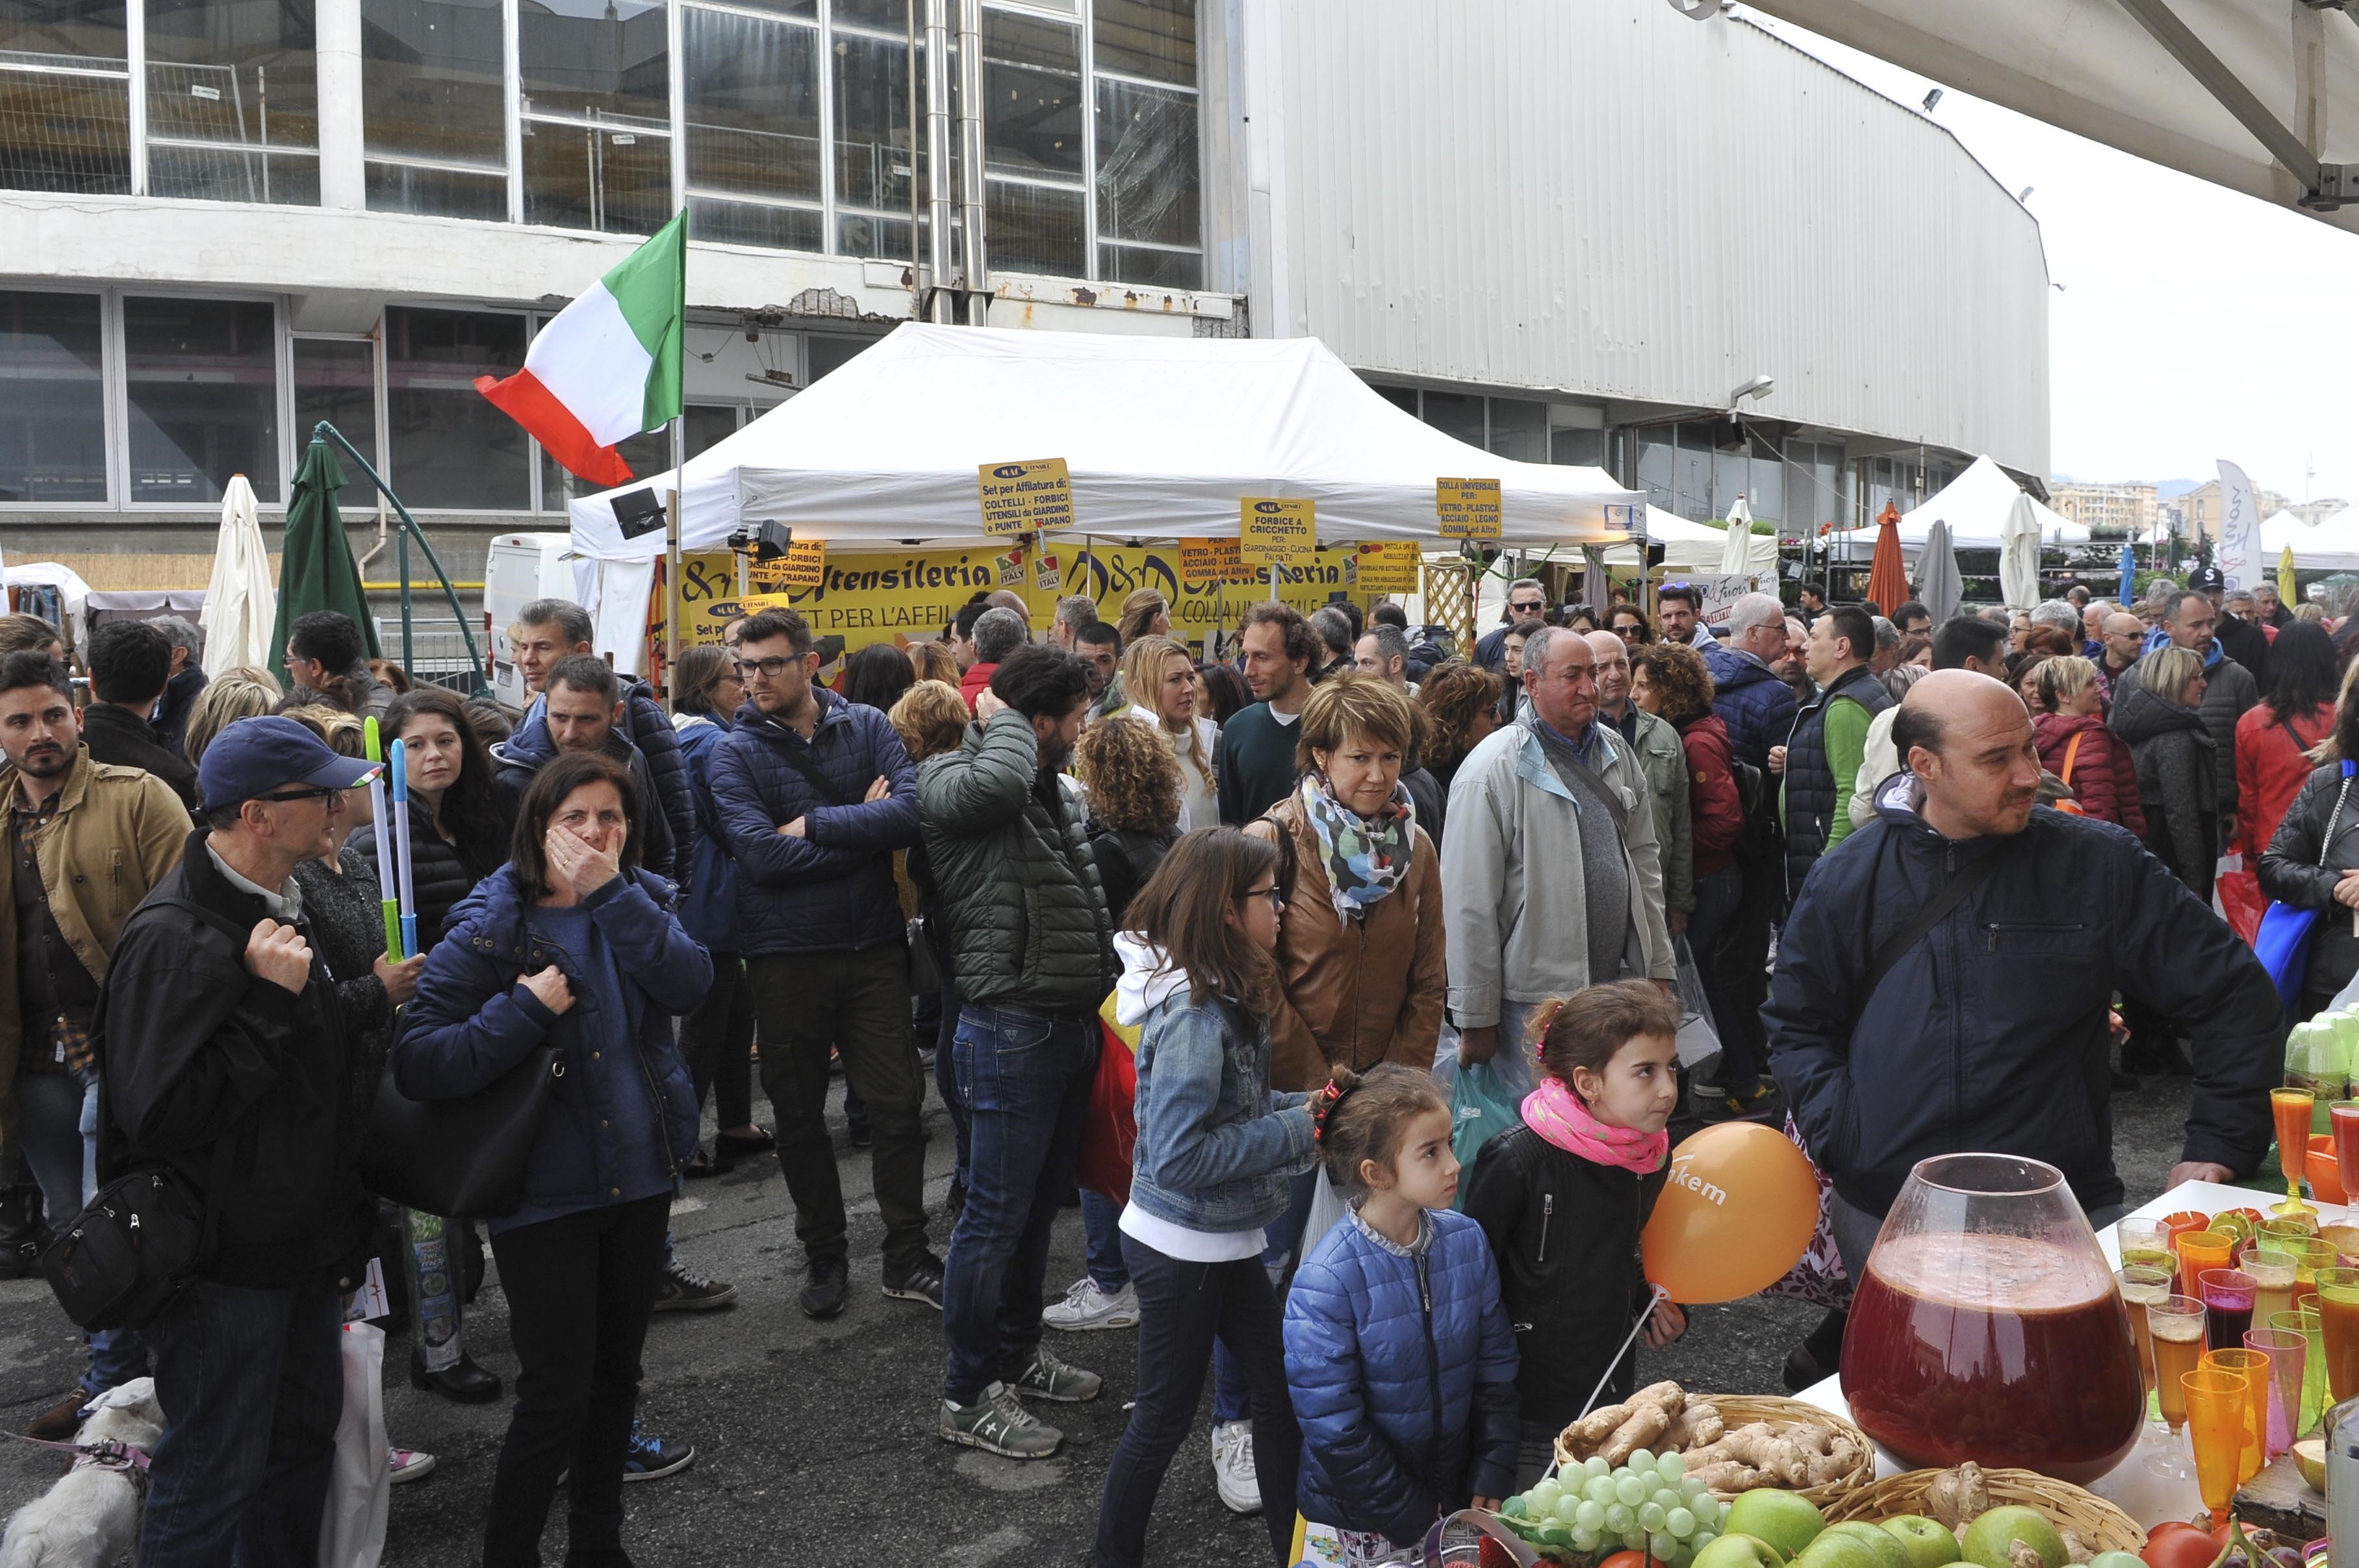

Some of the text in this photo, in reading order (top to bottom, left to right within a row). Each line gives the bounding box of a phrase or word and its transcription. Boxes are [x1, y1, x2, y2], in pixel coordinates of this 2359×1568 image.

[982, 479, 1067, 496] Set per Affilatura di:
[1439, 481, 1499, 490] COLLA UNIVERSALE
[984, 498, 1025, 509] COLTELLI
[1034, 493, 1068, 504] FORBICI
[986, 510, 1021, 520] UTENSILI
[1033, 504, 1069, 515] GIARDINO
[1440, 503, 1462, 512] VETRO
[1466, 504, 1499, 512] PLASTICA
[1255, 516, 1294, 525] FORBICE
[1475, 514, 1498, 523] LEGNO
[995, 520, 1023, 531] PUNTE
[1249, 525, 1307, 535] CRICCHETTO
[1182, 548, 1208, 557] VETRO
[1214, 546, 1241, 555] PLASTI
[782, 563, 820, 573] GIARDINO
[1183, 558, 1216, 567] ACCIAIO
[782, 573, 820, 583] TRAPANO
[1001, 570, 1025, 583] ITALY
[1186, 568, 1217, 577] GOMMA
[1346, 572, 1357, 583] ITAL
[2205, 568, 2215, 581] S
[1039, 575, 1060, 588] ITALY
[830, 607, 874, 628] PER
[1182, 600, 1233, 624] COLLA
[696, 624, 713, 635] Set
[1666, 1165, 1727, 1206] nkem
